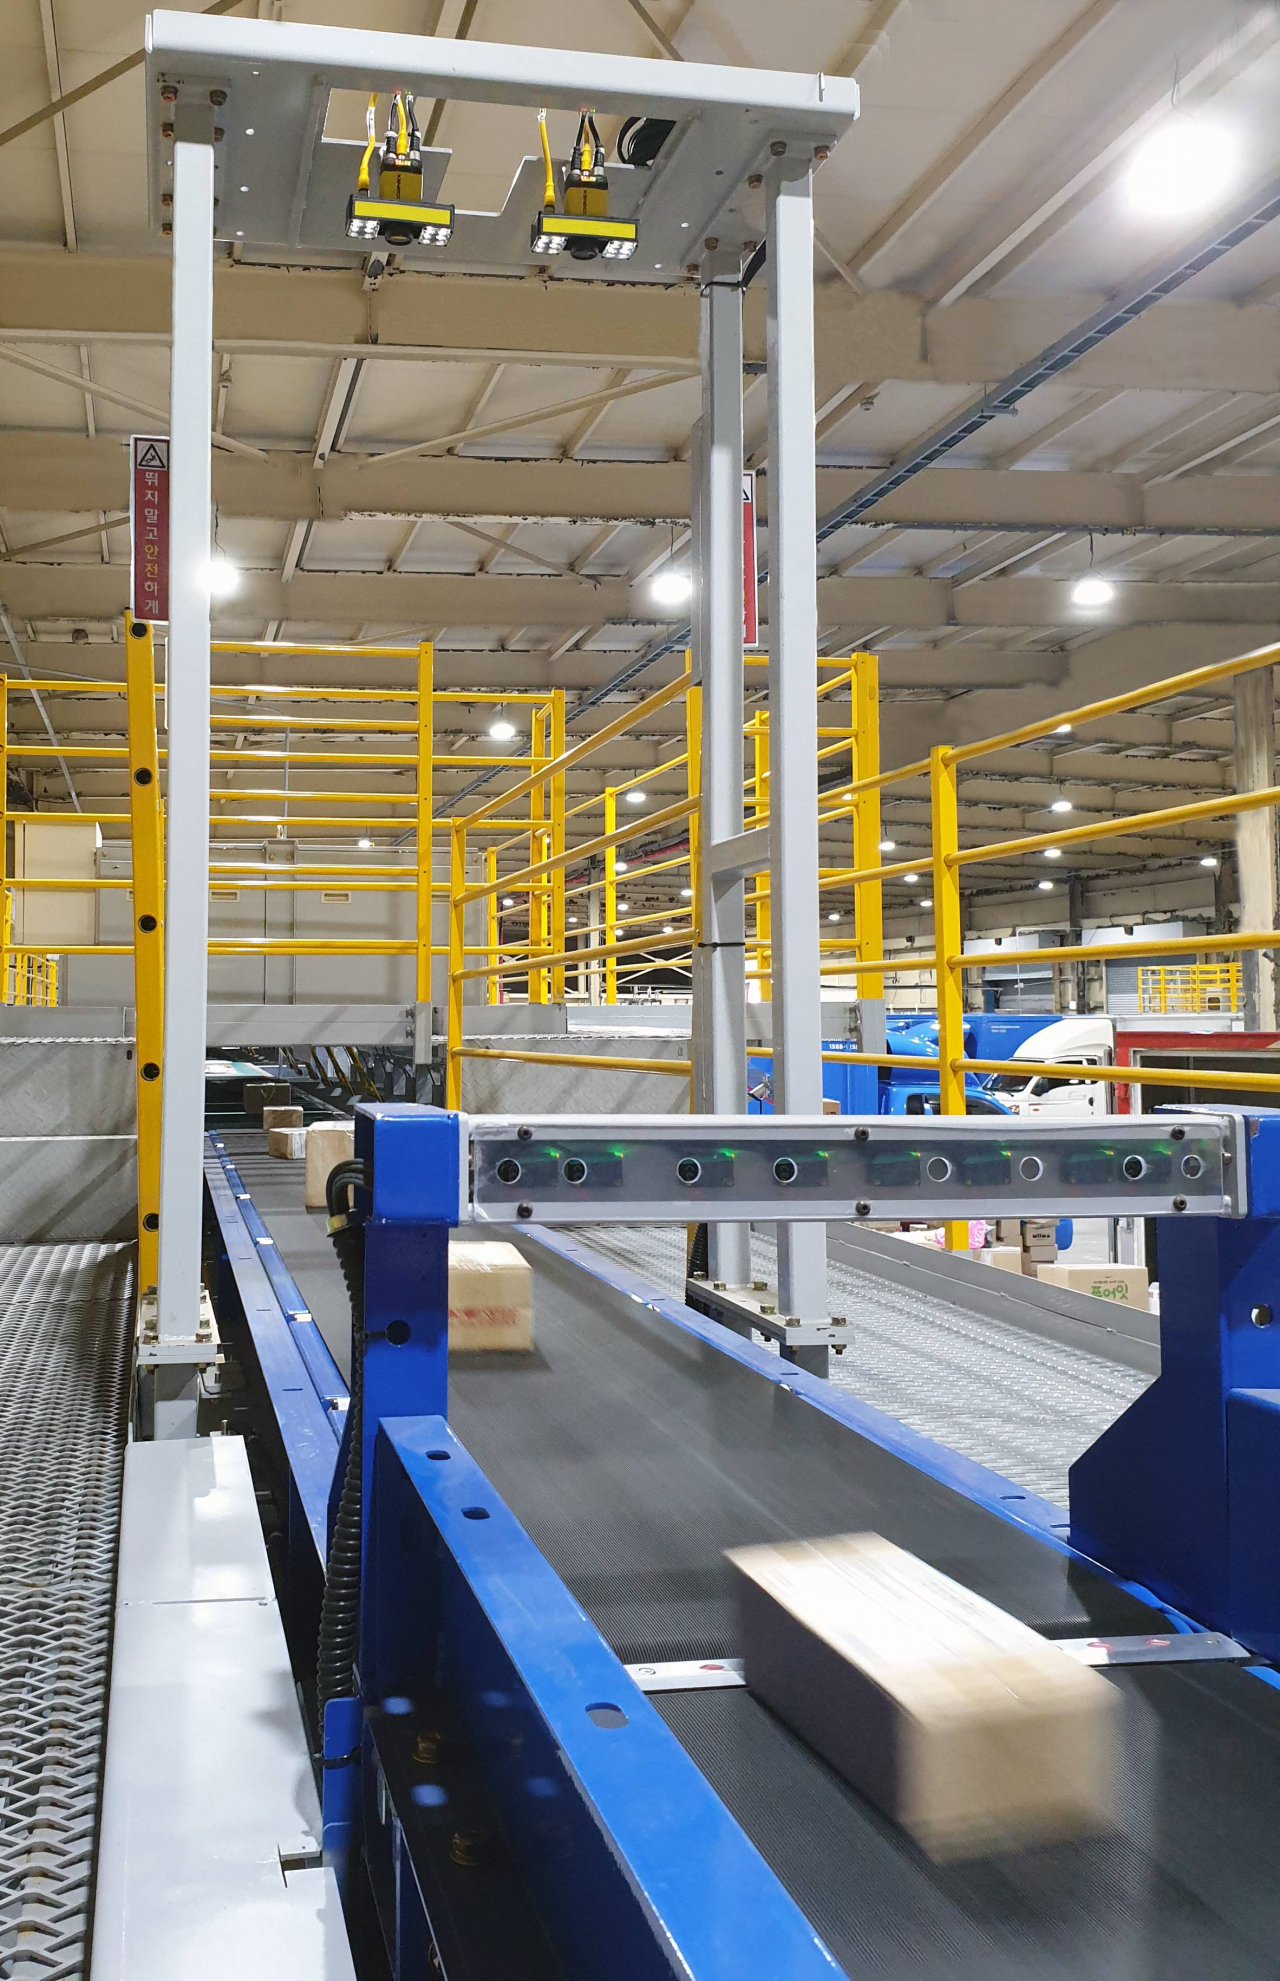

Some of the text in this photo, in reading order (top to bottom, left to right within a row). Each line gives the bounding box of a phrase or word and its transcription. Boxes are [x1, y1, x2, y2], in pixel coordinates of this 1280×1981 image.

[144, 471, 160, 615] 뛰지 말고 안전하게
